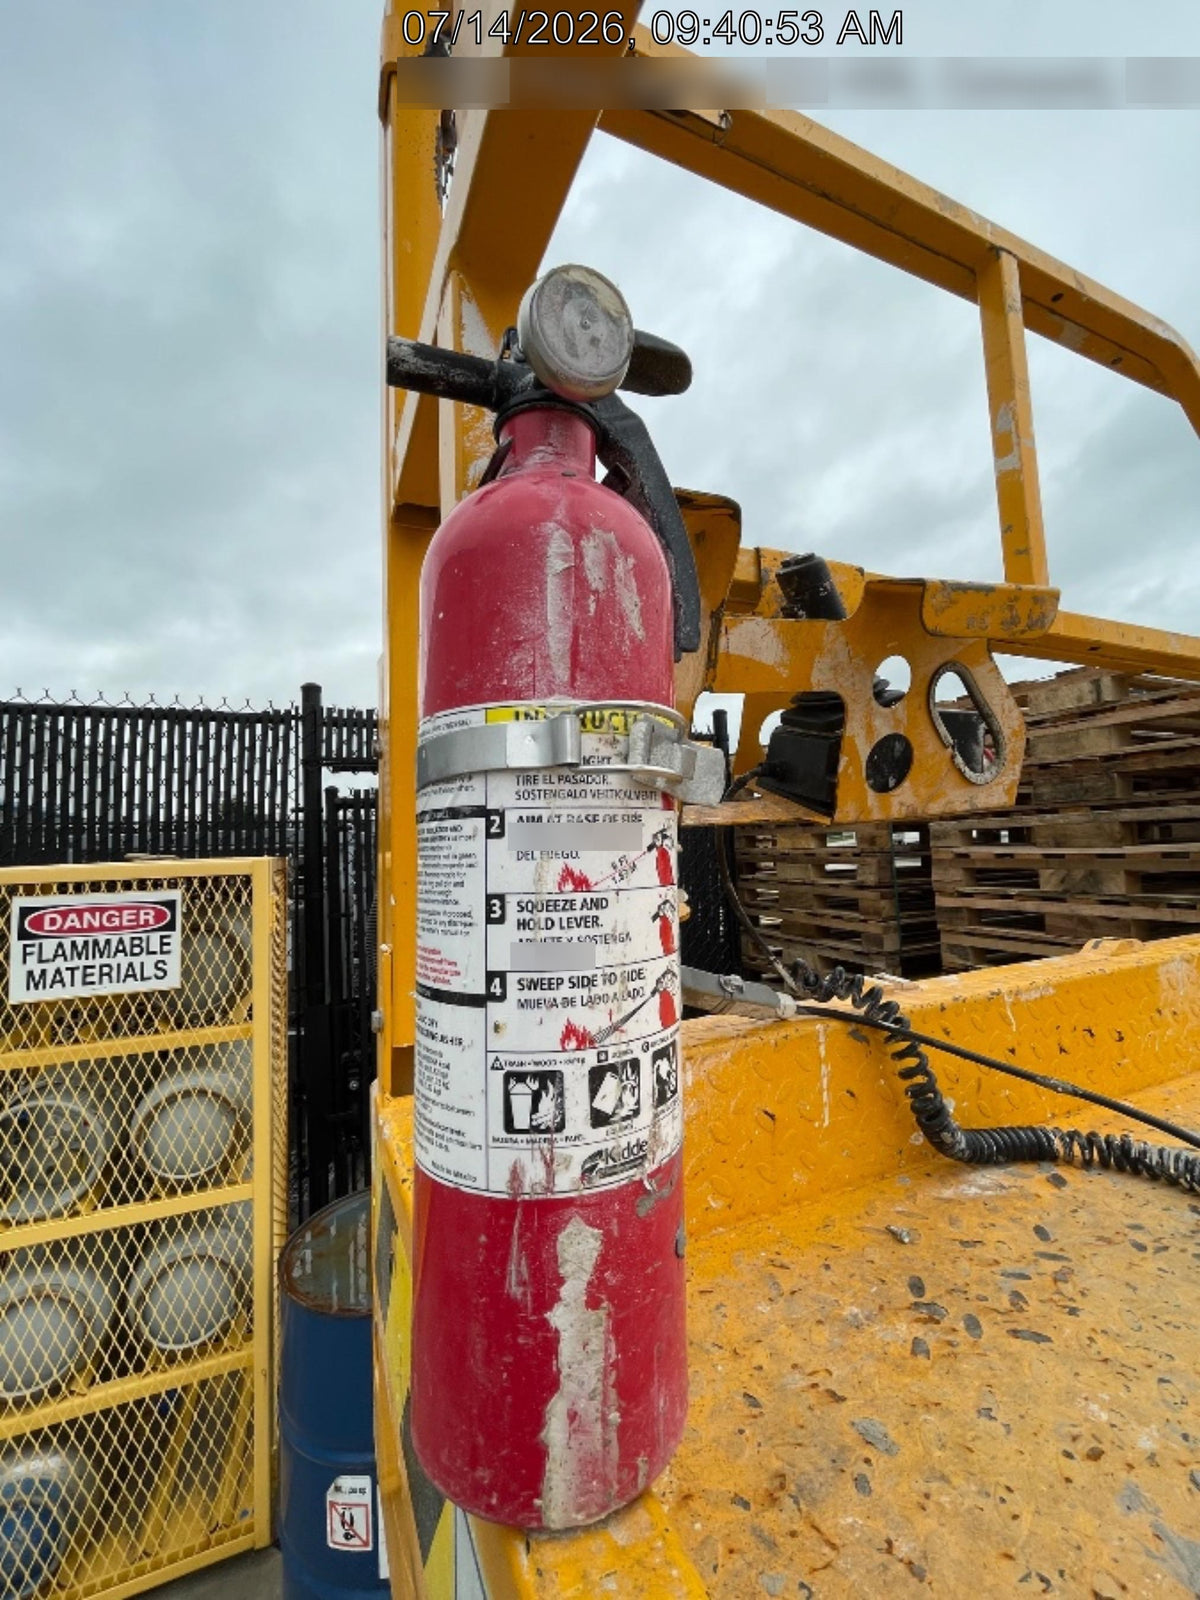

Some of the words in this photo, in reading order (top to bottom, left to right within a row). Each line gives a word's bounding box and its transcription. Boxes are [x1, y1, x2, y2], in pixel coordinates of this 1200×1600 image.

[515, 774, 540, 786] TIRE
[542, 774, 555, 784] EL
[489, 815, 502, 833] 2
[489, 899, 503, 918] 3
[516, 900, 577, 913] SQUEEZE
[579, 897, 609, 912] AND
[43, 909, 156, 931] DANGER
[516, 917, 556, 931] HOLD
[559, 915, 604, 930] LEVER.
[22, 935, 172, 965] FLAMMABLE
[26, 960, 168, 991] MATERIALS
[517, 977, 565, 991] SWEEP
[568, 976, 599, 990] SIDE
[601, 972, 618, 986] TO
[490, 977, 503, 996] 4
[604, 1138, 648, 1165] Kdde
